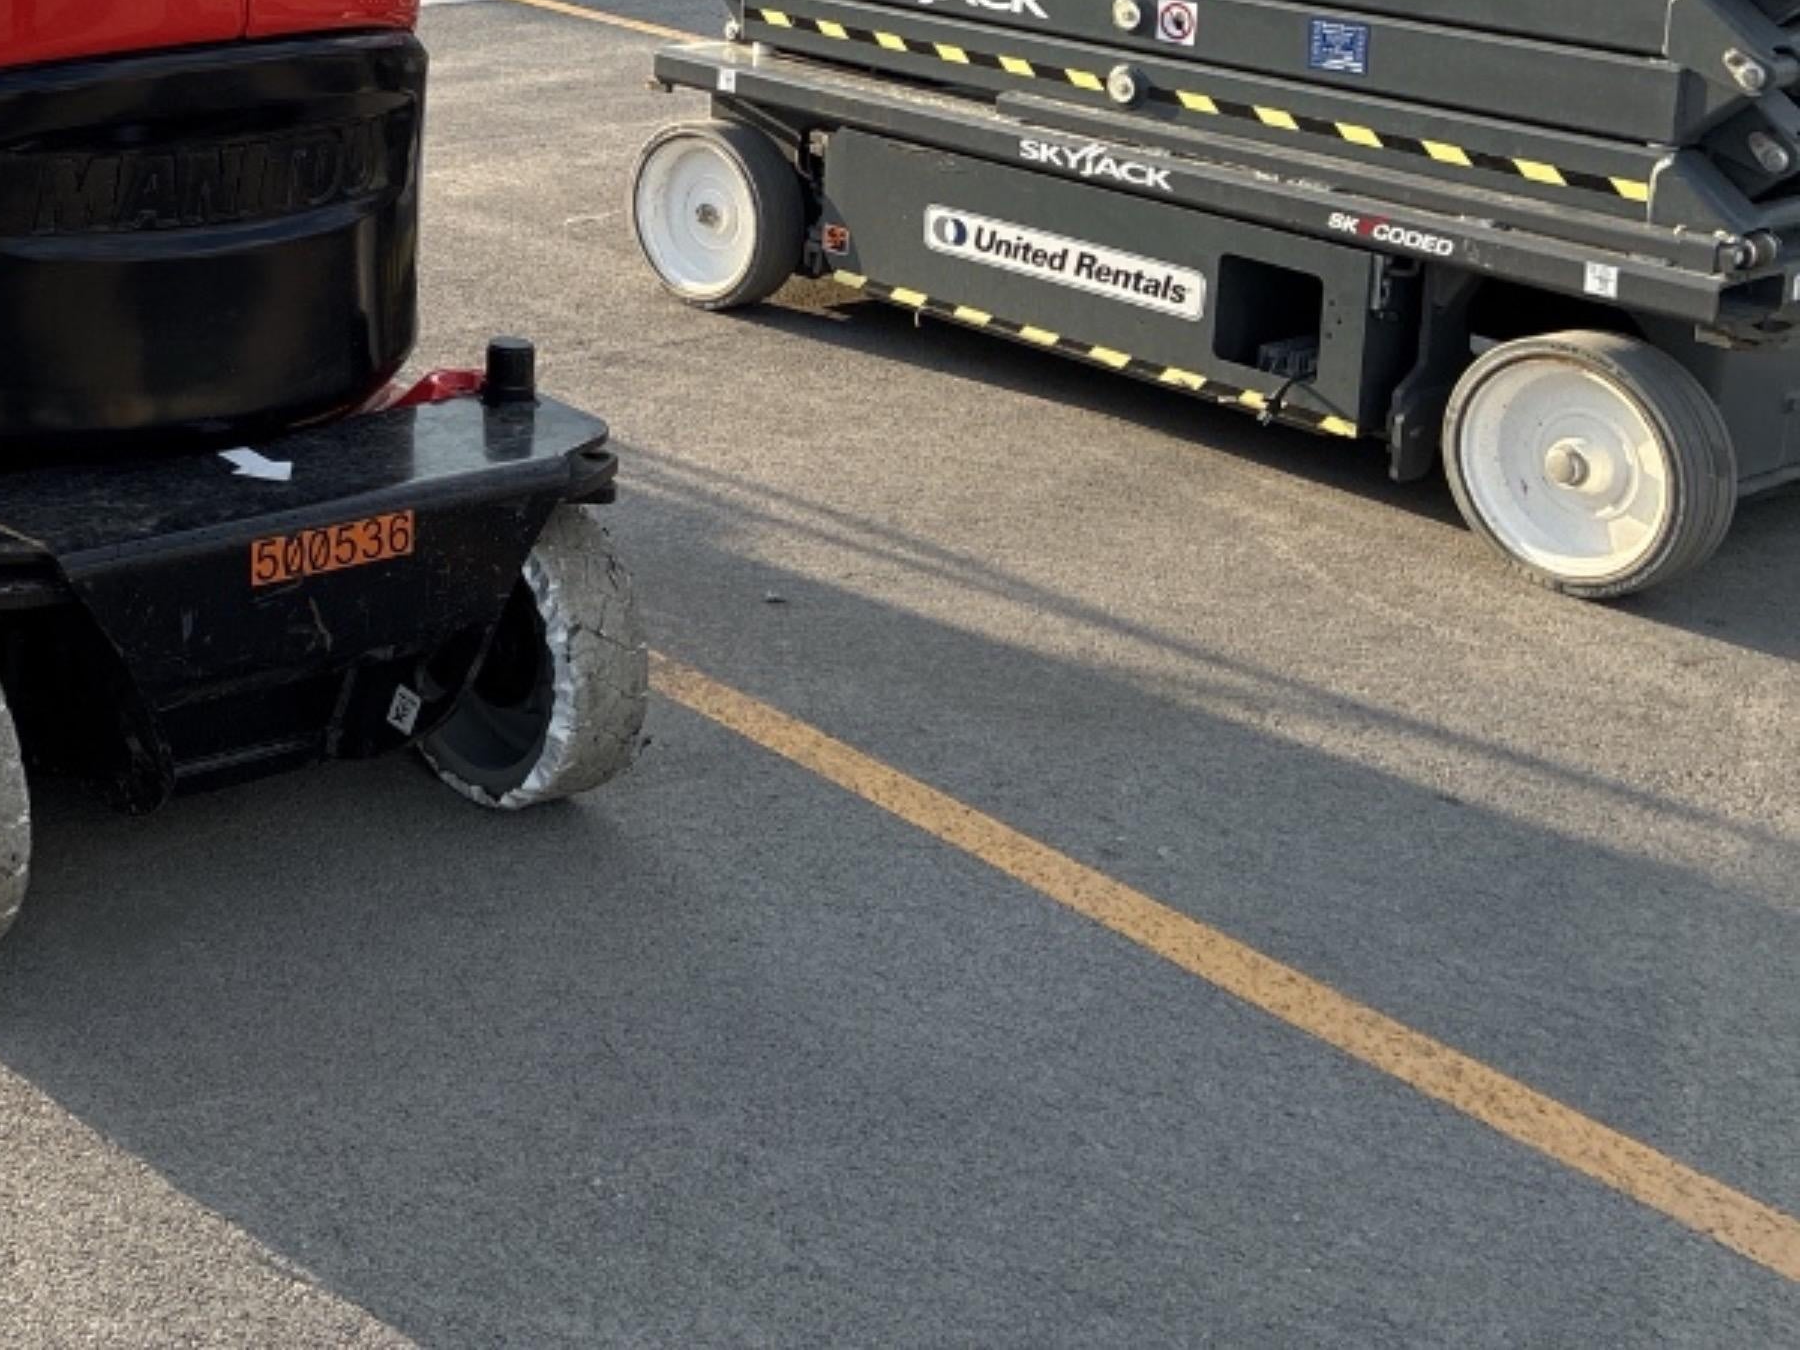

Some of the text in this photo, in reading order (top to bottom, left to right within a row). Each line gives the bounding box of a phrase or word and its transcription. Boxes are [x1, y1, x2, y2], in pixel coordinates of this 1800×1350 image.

[1018, 139, 1174, 193] SKYJACK
[974, 224, 1187, 305] United Rentals
[255, 515, 410, 581] 500536
